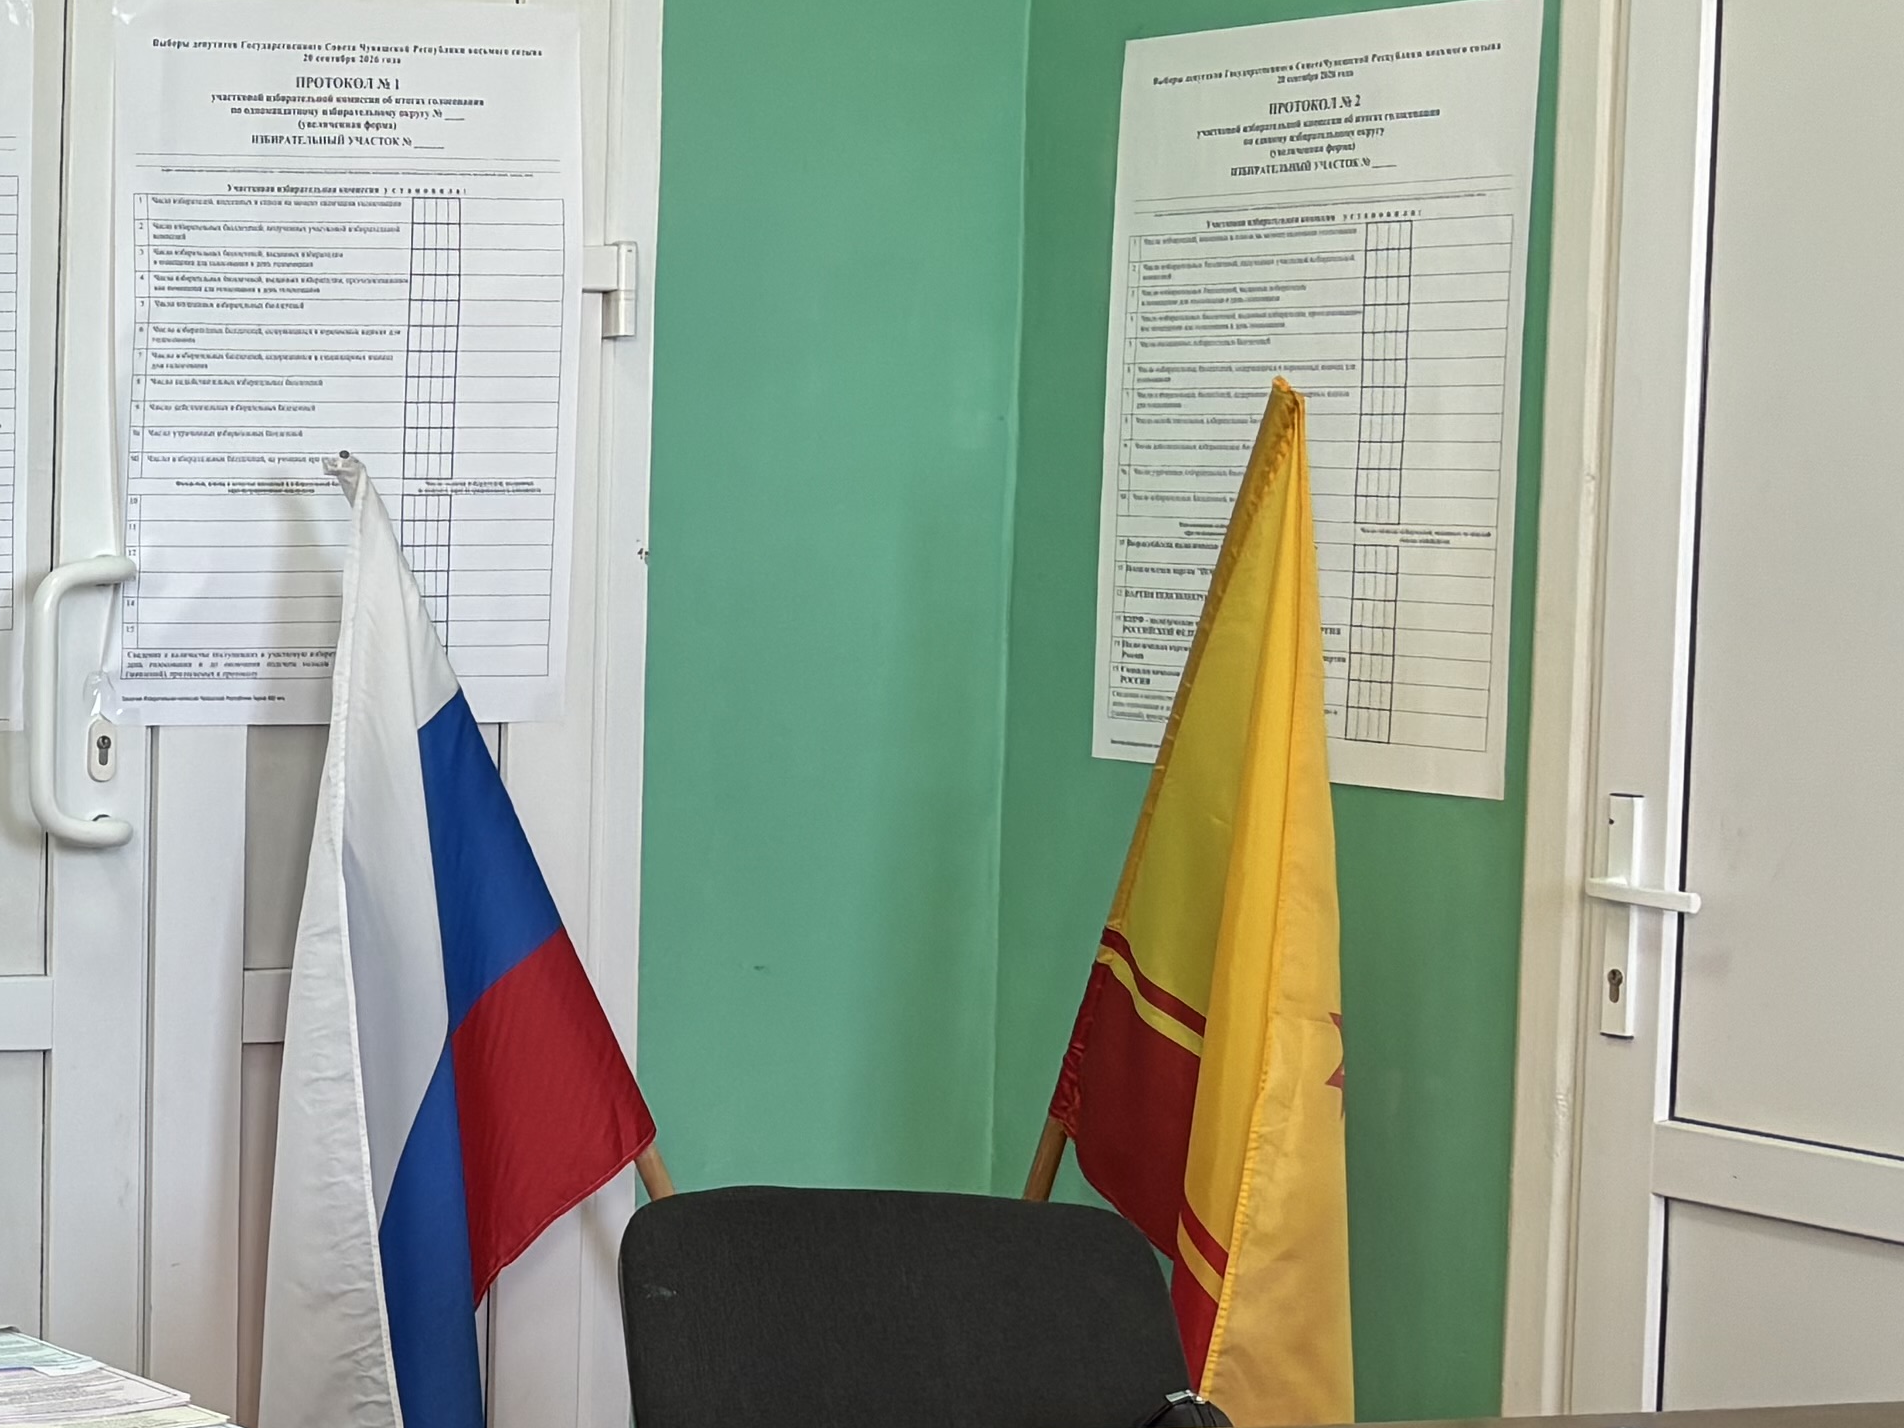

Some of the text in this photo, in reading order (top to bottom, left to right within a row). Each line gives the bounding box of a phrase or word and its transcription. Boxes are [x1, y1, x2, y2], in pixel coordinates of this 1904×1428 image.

[296, 76, 400, 90] ПРОТОКОЛ № 1
[1269, 94, 1361, 115] ПРОТОКОЛ № 2
[252, 134, 412, 146] ИЗБИРАТЕЛЬНЫЙ УЧАСТОК №
